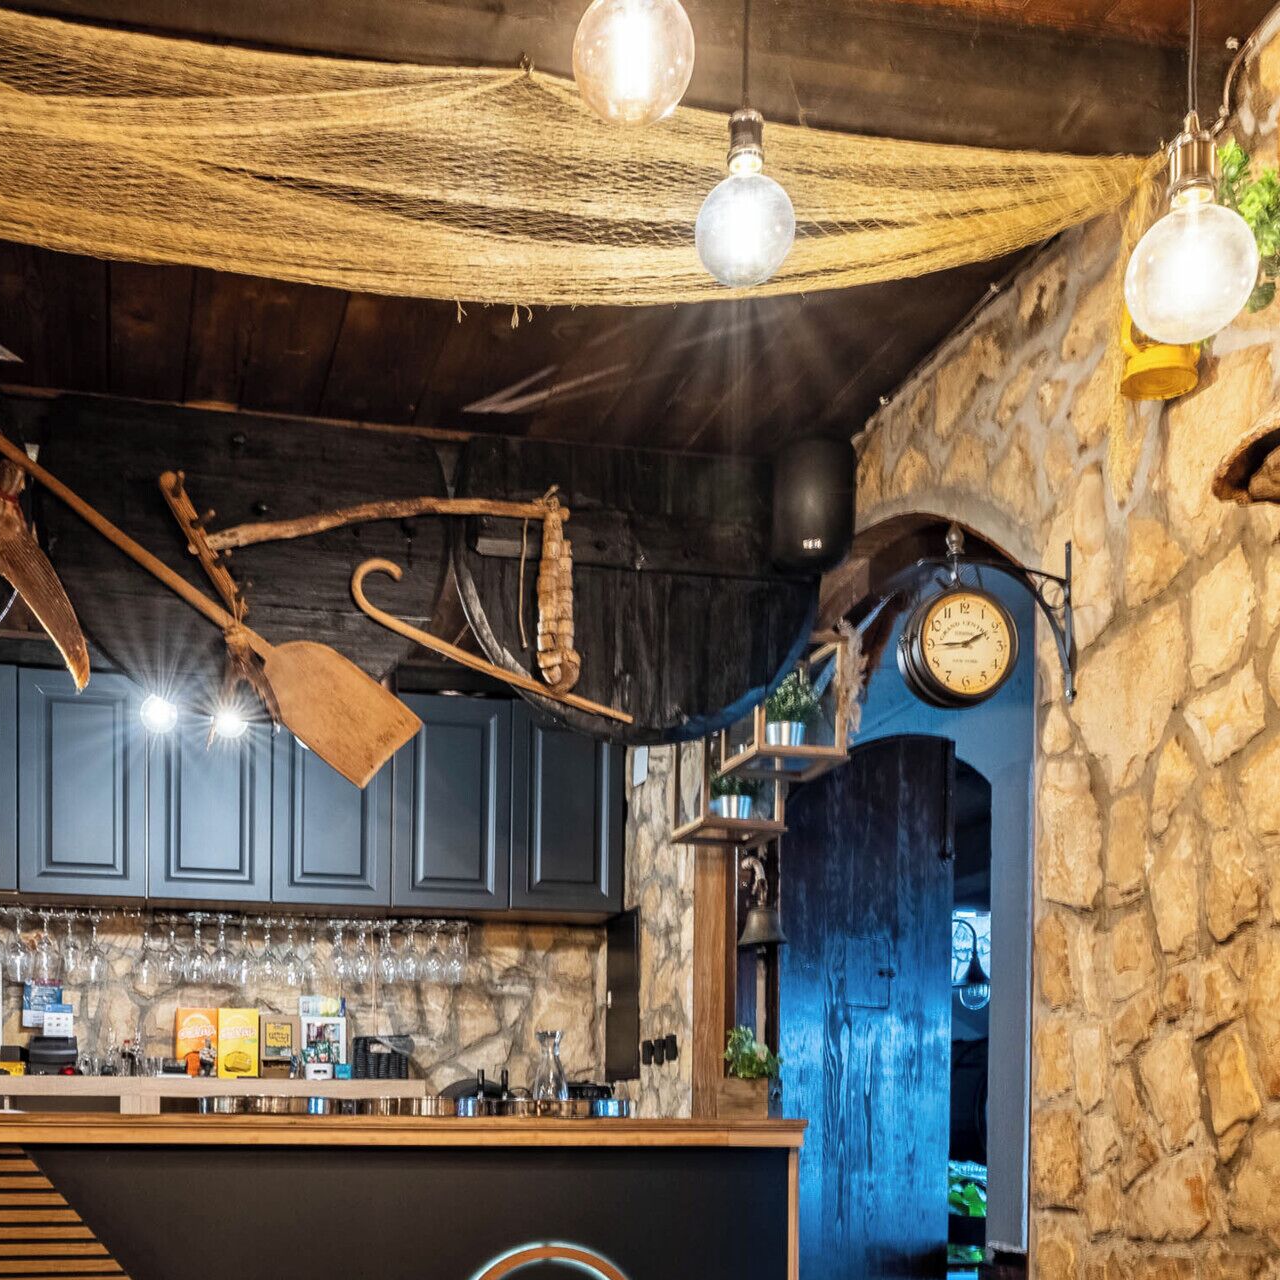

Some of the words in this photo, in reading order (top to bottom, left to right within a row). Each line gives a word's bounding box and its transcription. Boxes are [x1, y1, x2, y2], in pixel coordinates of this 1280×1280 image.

[944, 607, 951, 618] 11
[960, 602, 970, 614] 12
[931, 619, 941, 632] 10
[991, 622, 999, 633] 2
[927, 638, 935, 650] 9
[996, 640, 1003, 652] 3
[932, 656, 940, 668] 8
[991, 658, 998, 669] 4
[945, 670, 952, 682] 7
[962, 675, 970, 687] 6
[979, 671, 987, 683] 5
